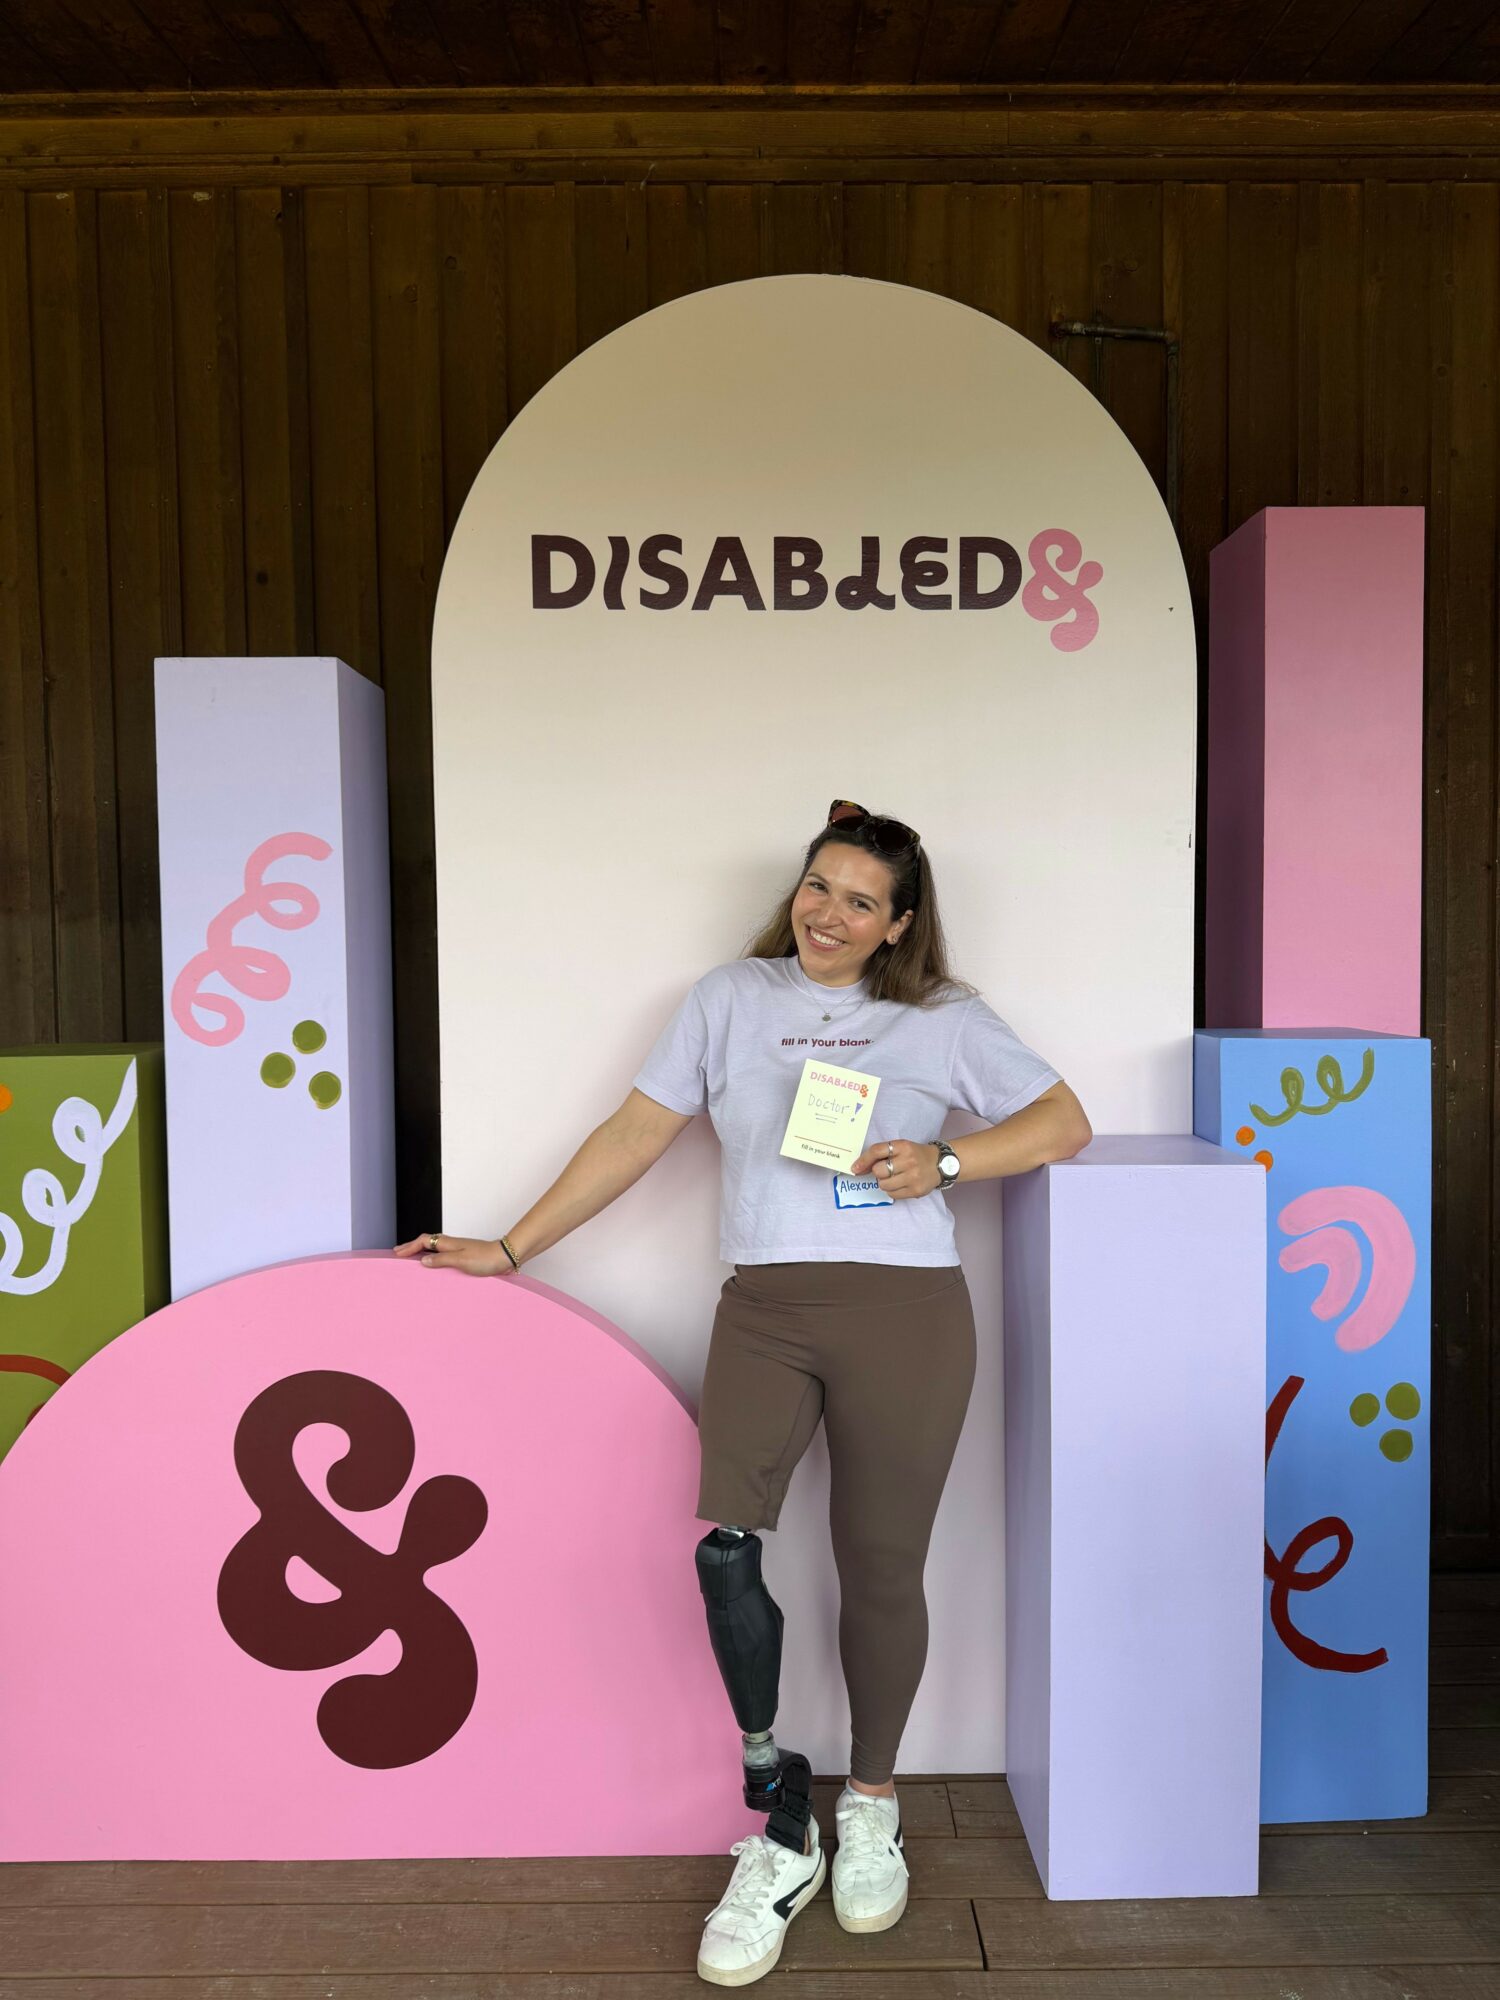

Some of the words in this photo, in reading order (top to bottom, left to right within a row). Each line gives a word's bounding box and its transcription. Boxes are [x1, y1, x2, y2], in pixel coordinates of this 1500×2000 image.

[531, 528, 1104, 652] DISABLED&
[782, 1038, 795, 1046] fill
[811, 1038, 837, 1048] your
[810, 1071, 869, 1098] DISABLED&
[827, 1151, 840, 1159] blank
[217, 1369, 489, 1770] &
